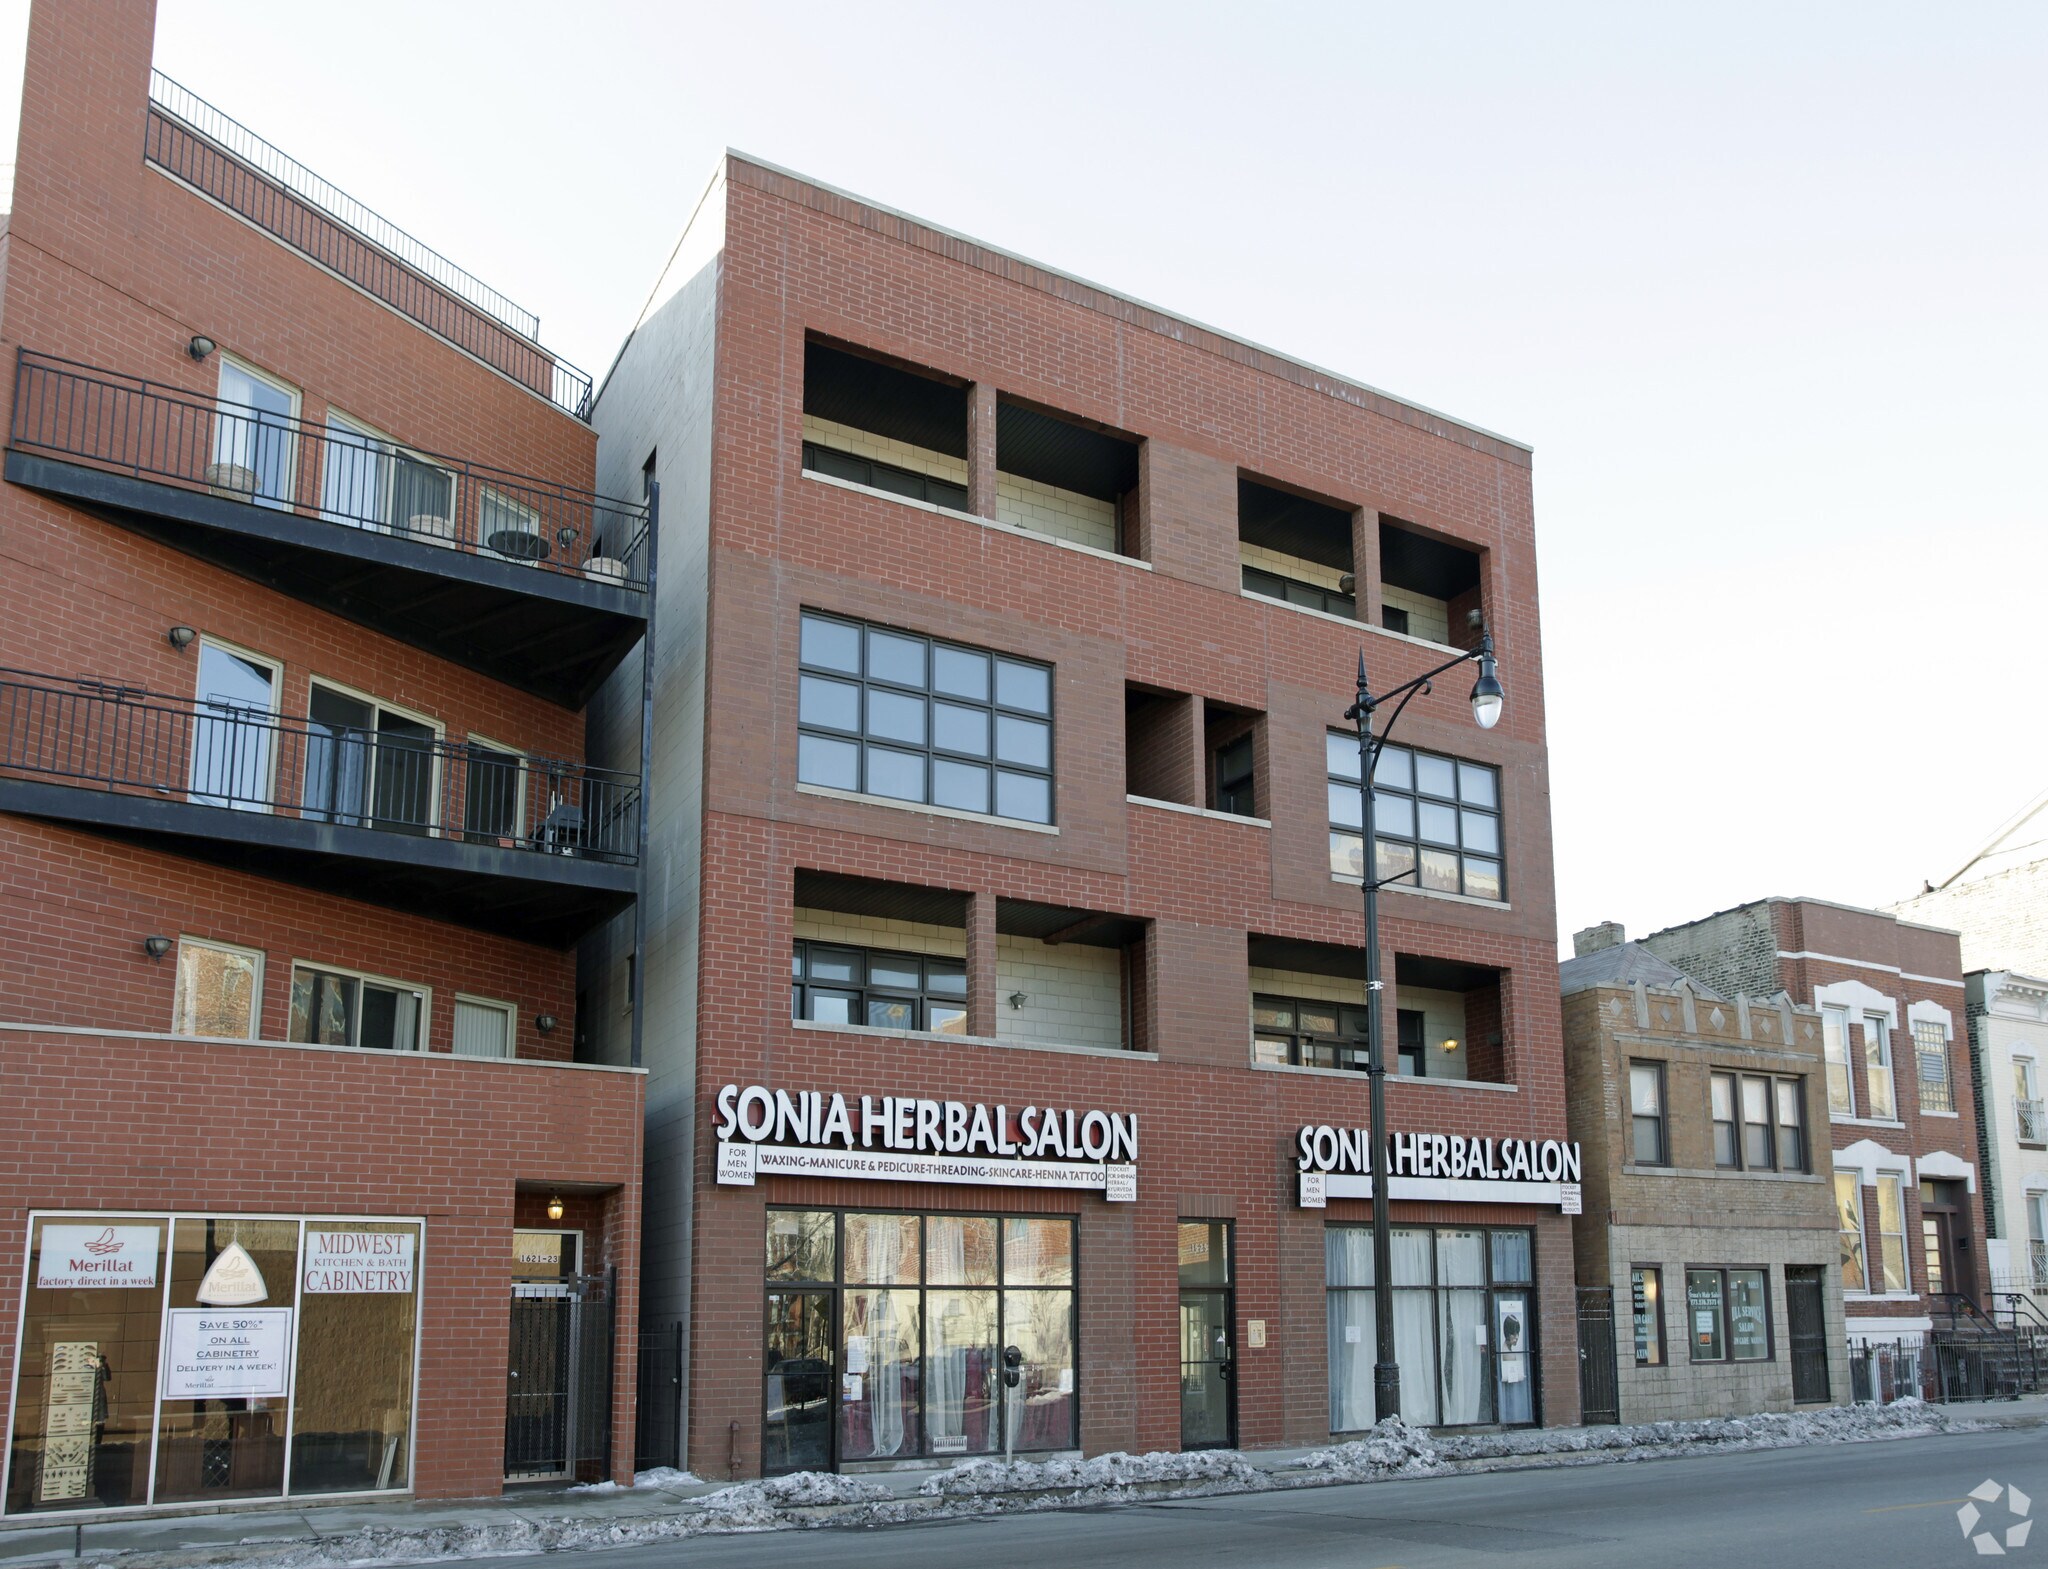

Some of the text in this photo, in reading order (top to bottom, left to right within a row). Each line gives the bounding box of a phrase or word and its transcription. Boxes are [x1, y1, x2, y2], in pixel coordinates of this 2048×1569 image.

[717, 1084, 1137, 1161] SONIA HERBAL SALON
[729, 1149, 747, 1157] FOR
[1394, 1131, 1500, 1179] HERBAL
[1501, 1137, 1581, 1182] SALON
[728, 1160, 747, 1168] MEN
[719, 1170, 755, 1180] WOMEN
[868, 1162, 876, 1171] &
[1069, 1171, 1105, 1182] TATTOO
[1301, 1196, 1326, 1204] WOMEN
[320, 1234, 405, 1254] MIDWEST
[314, 1258, 407, 1267] KITCHEN & BATH
[520, 1255, 558, 1263] 1621-23
[70, 1259, 132, 1272] Merillat
[40, 1276, 74, 1288] factory
[78, 1276, 106, 1286] direct
[110, 1276, 118, 1286] in
[131, 1276, 154, 1286] week
[306, 1270, 411, 1291] CABINETRY
[1632, 1272, 1644, 1282] AILS
[208, 1281, 257, 1293] Merillat
[1732, 1306, 1740, 1322] ULL
[1738, 1322, 1754, 1332] SALON
[210, 1336, 250, 1344] ON ALL
[196, 1350, 260, 1358] CABINETRY
[247, 1363, 276, 1371] WEEK!
